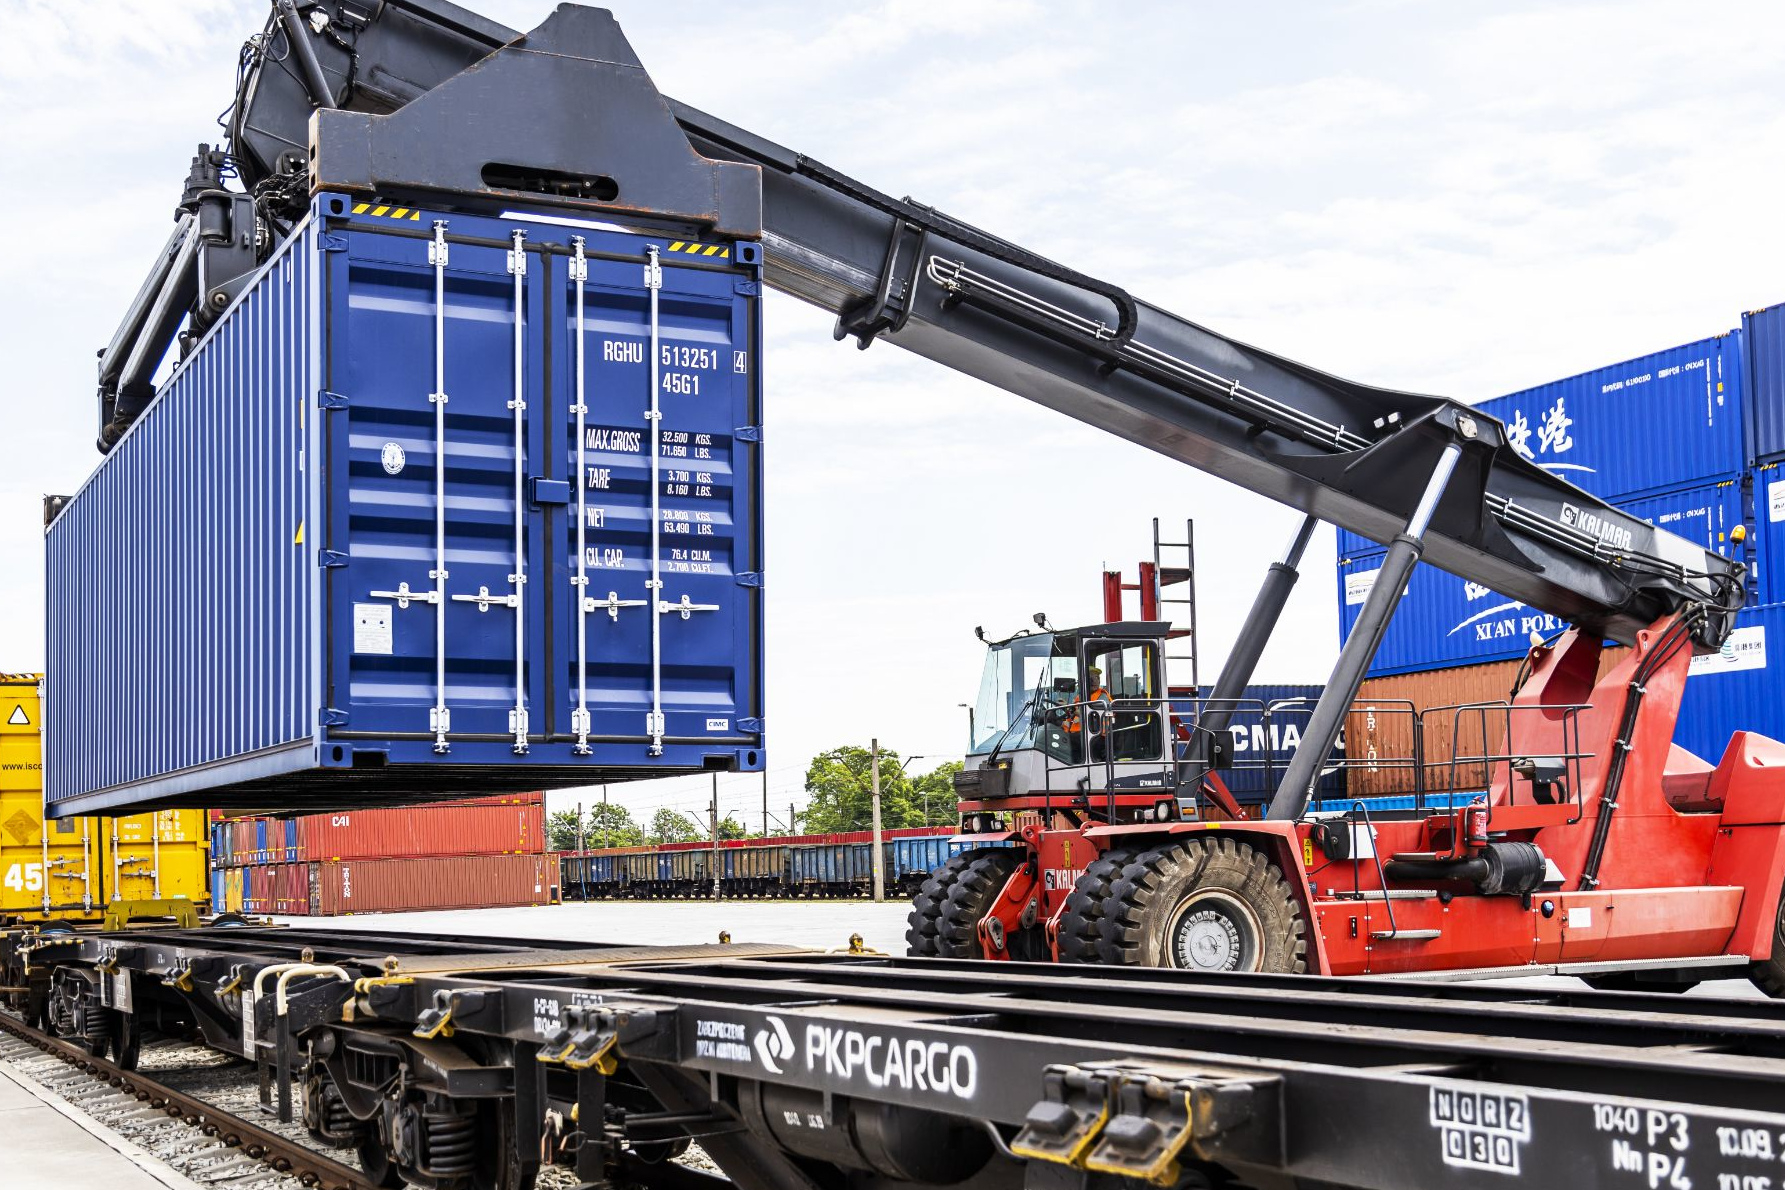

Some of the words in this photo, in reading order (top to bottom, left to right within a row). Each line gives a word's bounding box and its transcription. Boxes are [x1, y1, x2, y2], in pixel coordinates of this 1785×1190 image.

[603, 340, 643, 363] RGHU
[661, 345, 717, 370] 513251
[735, 352, 745, 372] 4
[662, 372, 699, 395] 45G1
[586, 428, 641, 452] MAX.GROSS
[662, 431, 688, 444] 32.500
[695, 433, 712, 446] KGS.
[661, 444, 687, 457] 71.650
[694, 447, 711, 459] LBS.
[588, 467, 611, 489] TARE
[668, 470, 690, 482] 3.700
[696, 471, 713, 484] KGS.
[667, 483, 689, 495] 8.160
[695, 485, 712, 497] LBS.
[587, 507, 605, 528] NET
[695, 511, 713, 522] KGS.
[664, 521, 690, 534] 63.490
[697, 523, 714, 536] LBS.
[1578, 510, 1632, 550] KALMAR
[604, 549, 625, 568] CAP.
[671, 548, 688, 560] 76.4
[667, 561, 689, 572] 2.700
[1475, 618, 1516, 641] XI'AN
[1228, 724, 1301, 752] CMA
[1366, 706, 1378, 773] TRON
[332, 815, 350, 827] CAI
[4, 863, 43, 892] 45
[1056, 869, 1086, 890] KALM
[1593, 1103, 1640, 1135] 1040
